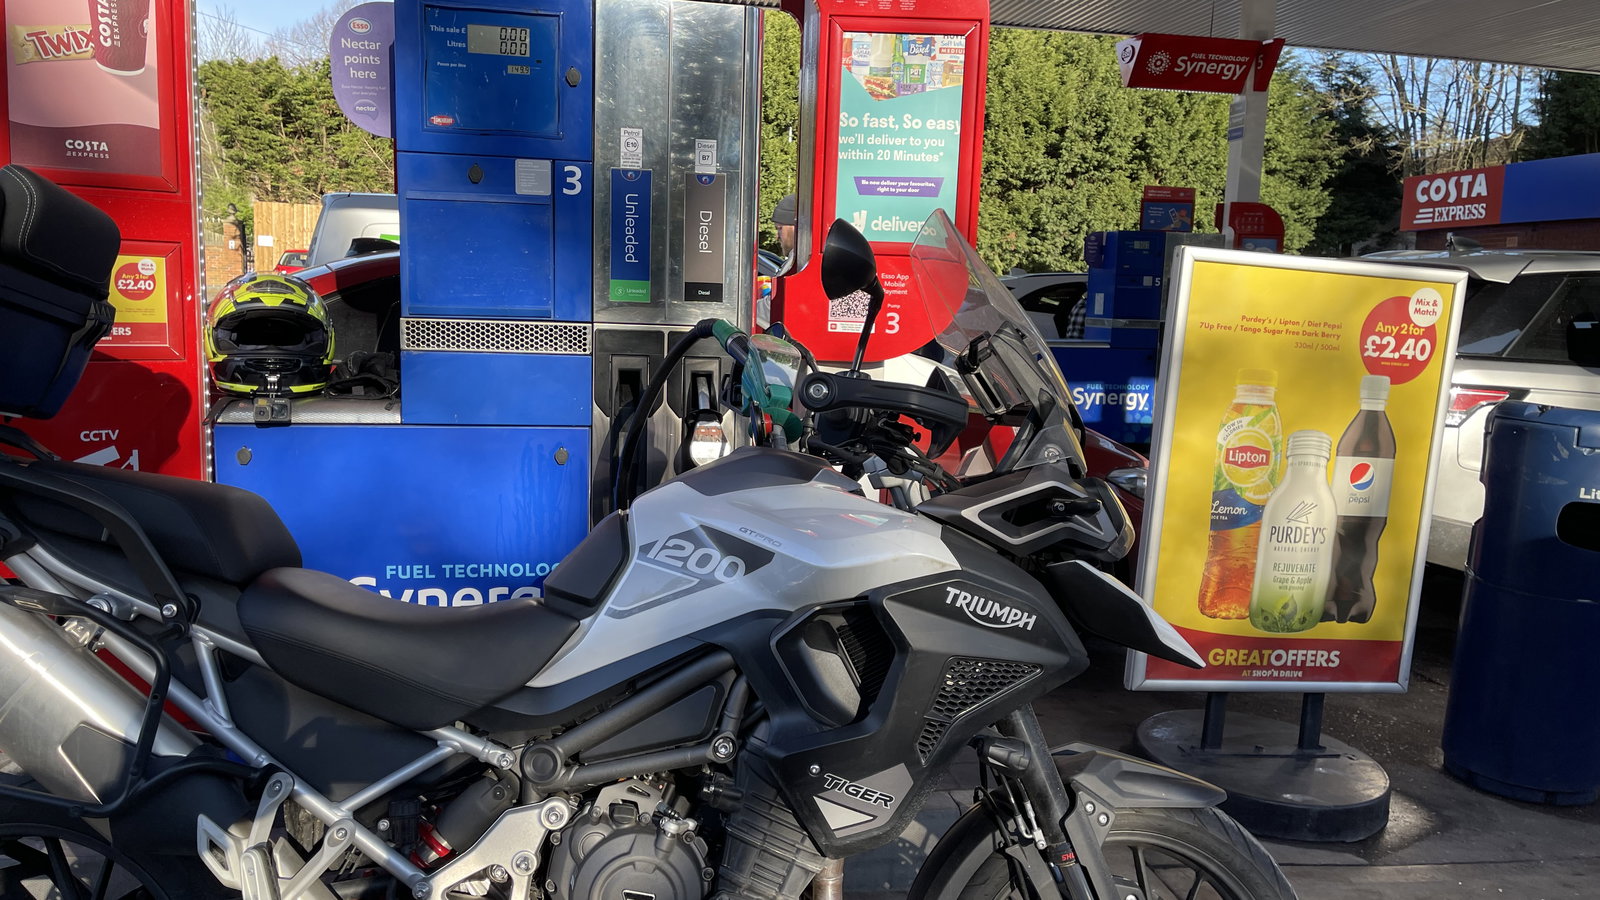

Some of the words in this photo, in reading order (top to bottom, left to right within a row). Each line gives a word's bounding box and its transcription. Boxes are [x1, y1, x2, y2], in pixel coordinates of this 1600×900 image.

[352, 22, 369, 30] Esso
[429, 24, 445, 32] This
[341, 38, 381, 50] Nectar
[447, 40, 467, 48] Litres
[344, 53, 381, 66] points
[1208, 53, 1250, 63] TECHNOLOGY
[1257, 54, 1264, 70] 5
[350, 67, 377, 79] here
[1174, 56, 1247, 80] Synergy
[840, 112, 858, 127] So
[863, 112, 899, 131] fast,
[903, 114, 922, 129] So
[926, 119, 961, 135] easy
[65, 139, 109, 151] COSTA
[839, 134, 864, 144] we'll
[867, 134, 909, 146] deliver
[910, 136, 921, 146] to
[924, 138, 945, 149] you
[72, 151, 110, 159] EXPRESS
[839, 149, 874, 160] within
[877, 150, 891, 160] 20
[562, 165, 582, 195] 3
[1416, 173, 1488, 203] COSTA
[1433, 203, 1487, 223] EXPRESS
[625, 193, 639, 263] Unleaded
[699, 210, 713, 253] Diesel
[117, 279, 154, 290] £2.40
[896, 273, 910, 281] App
[1154, 278, 1161, 286] 5
[1415, 298, 1430, 307] Mix
[1431, 299, 1438, 307] &
[1413, 307, 1437, 316] Match
[885, 312, 900, 334] 3
[1241, 314, 1272, 325] Purdey's
[1279, 318, 1300, 327] Lipton
[1307, 320, 1322, 329] Diet
[1323, 322, 1342, 330] Pepsi
[1375, 321, 1399, 337] Any
[1400, 323, 1408, 335] 2
[1408, 323, 1425, 336] for
[111, 327, 132, 336] ERS
[1200, 321, 1215, 331] 7Up
[1217, 323, 1233, 331] Free
[1240, 325, 1262, 335] Tango
[1263, 327, 1283, 337] Sugar
[1285, 328, 1300, 336] Free
[1302, 329, 1319, 338] Dark
[1321, 331, 1341, 341] Berry
[1294, 341, 1314, 350] 330ml
[1320, 343, 1341, 352] 500ml
[1364, 335, 1432, 362] £2.40
[1073, 387, 1150, 411] Synergy
[1223, 424, 1244, 441] CALORIES
[1224, 421, 1236, 432] LOW
[80, 429, 119, 442] CCTV
[1229, 449, 1267, 464] Lipton
[1211, 500, 1248, 515] Lemon
[1348, 496, 1370, 504] pepsi
[1269, 525, 1327, 545] PURDEY'S
[647, 535, 746, 584] 1200
[386, 564, 436, 580] FUEL
[442, 562, 561, 579] TECHNOLO
[1273, 562, 1316, 573] REJUVENATE
[1273, 575, 1289, 584] Grape
[1296, 576, 1312, 585] Apple
[945, 586, 1037, 631] TRIUMPH
[1208, 648, 1341, 668] GREATOFFERS
[824, 773, 896, 809] TIGER
